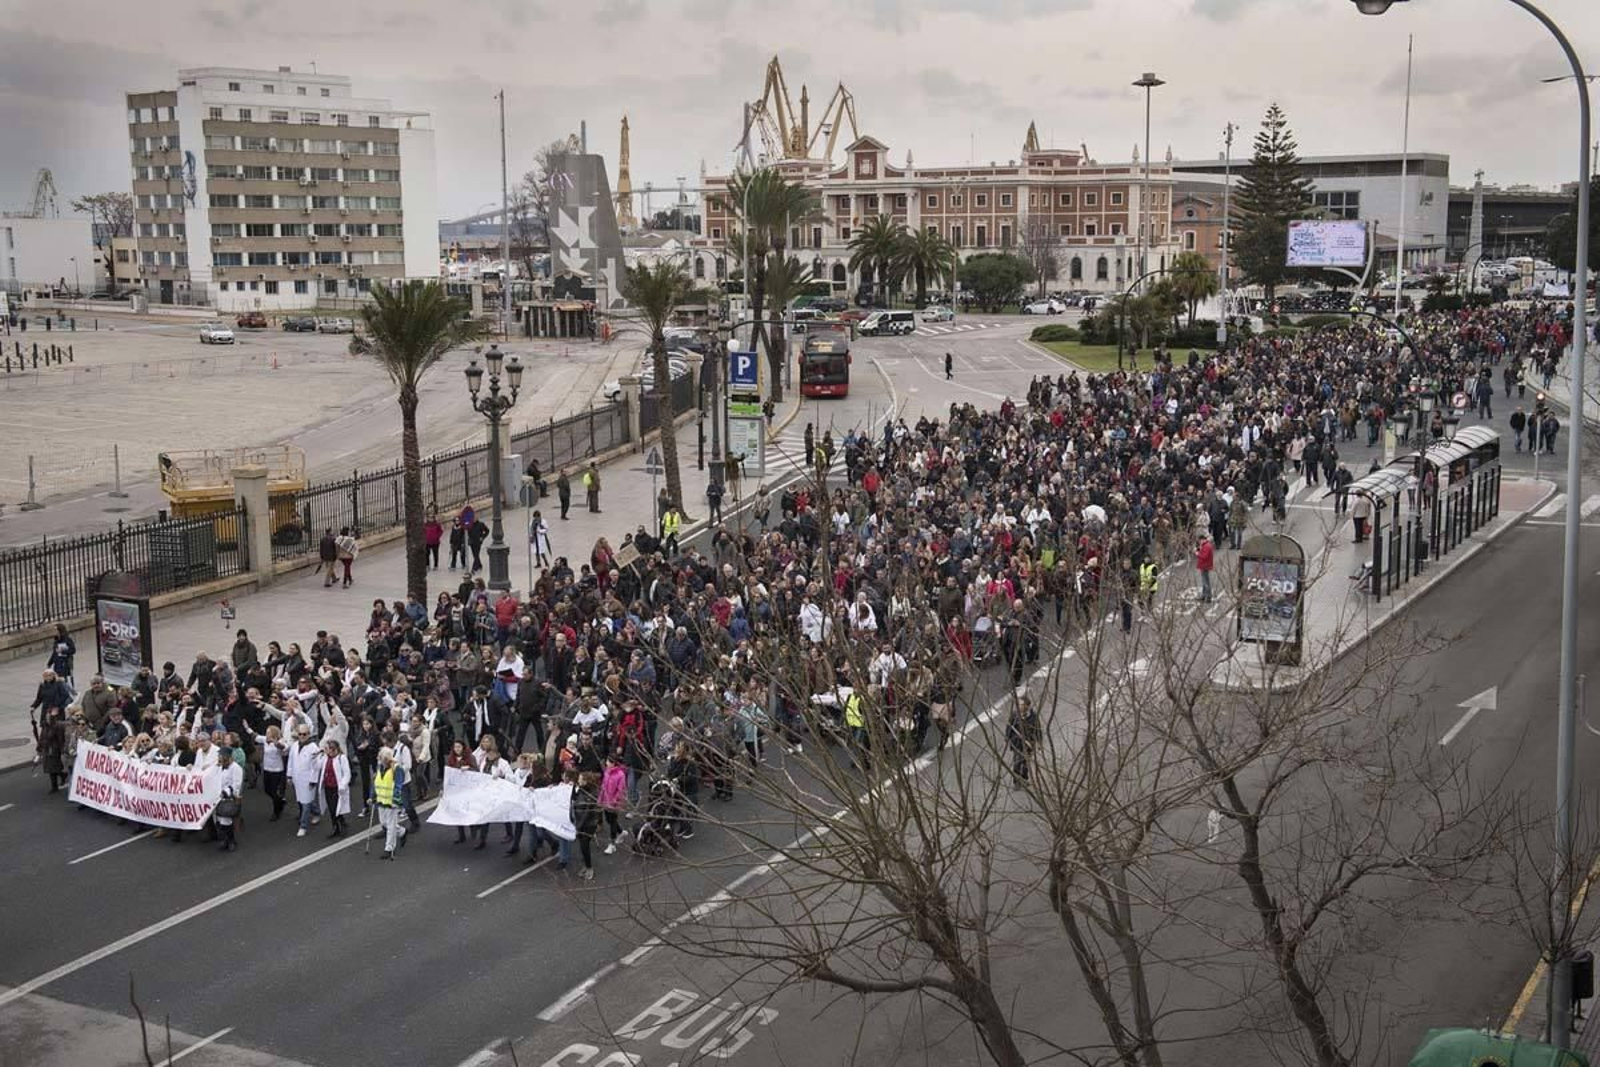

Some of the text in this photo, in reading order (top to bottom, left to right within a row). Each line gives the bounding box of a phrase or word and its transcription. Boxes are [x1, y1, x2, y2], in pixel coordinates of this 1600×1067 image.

[738, 356, 751, 376] P
[1247, 577, 1295, 593] FORD
[101, 620, 139, 639] FORD
[187, 774, 204, 795] EN
[75, 775, 111, 805] DEFENSA
[130, 795, 169, 821] SANIDAD
[170, 799, 216, 823] PÚBLIC
[612, 988, 780, 1058] BUS
